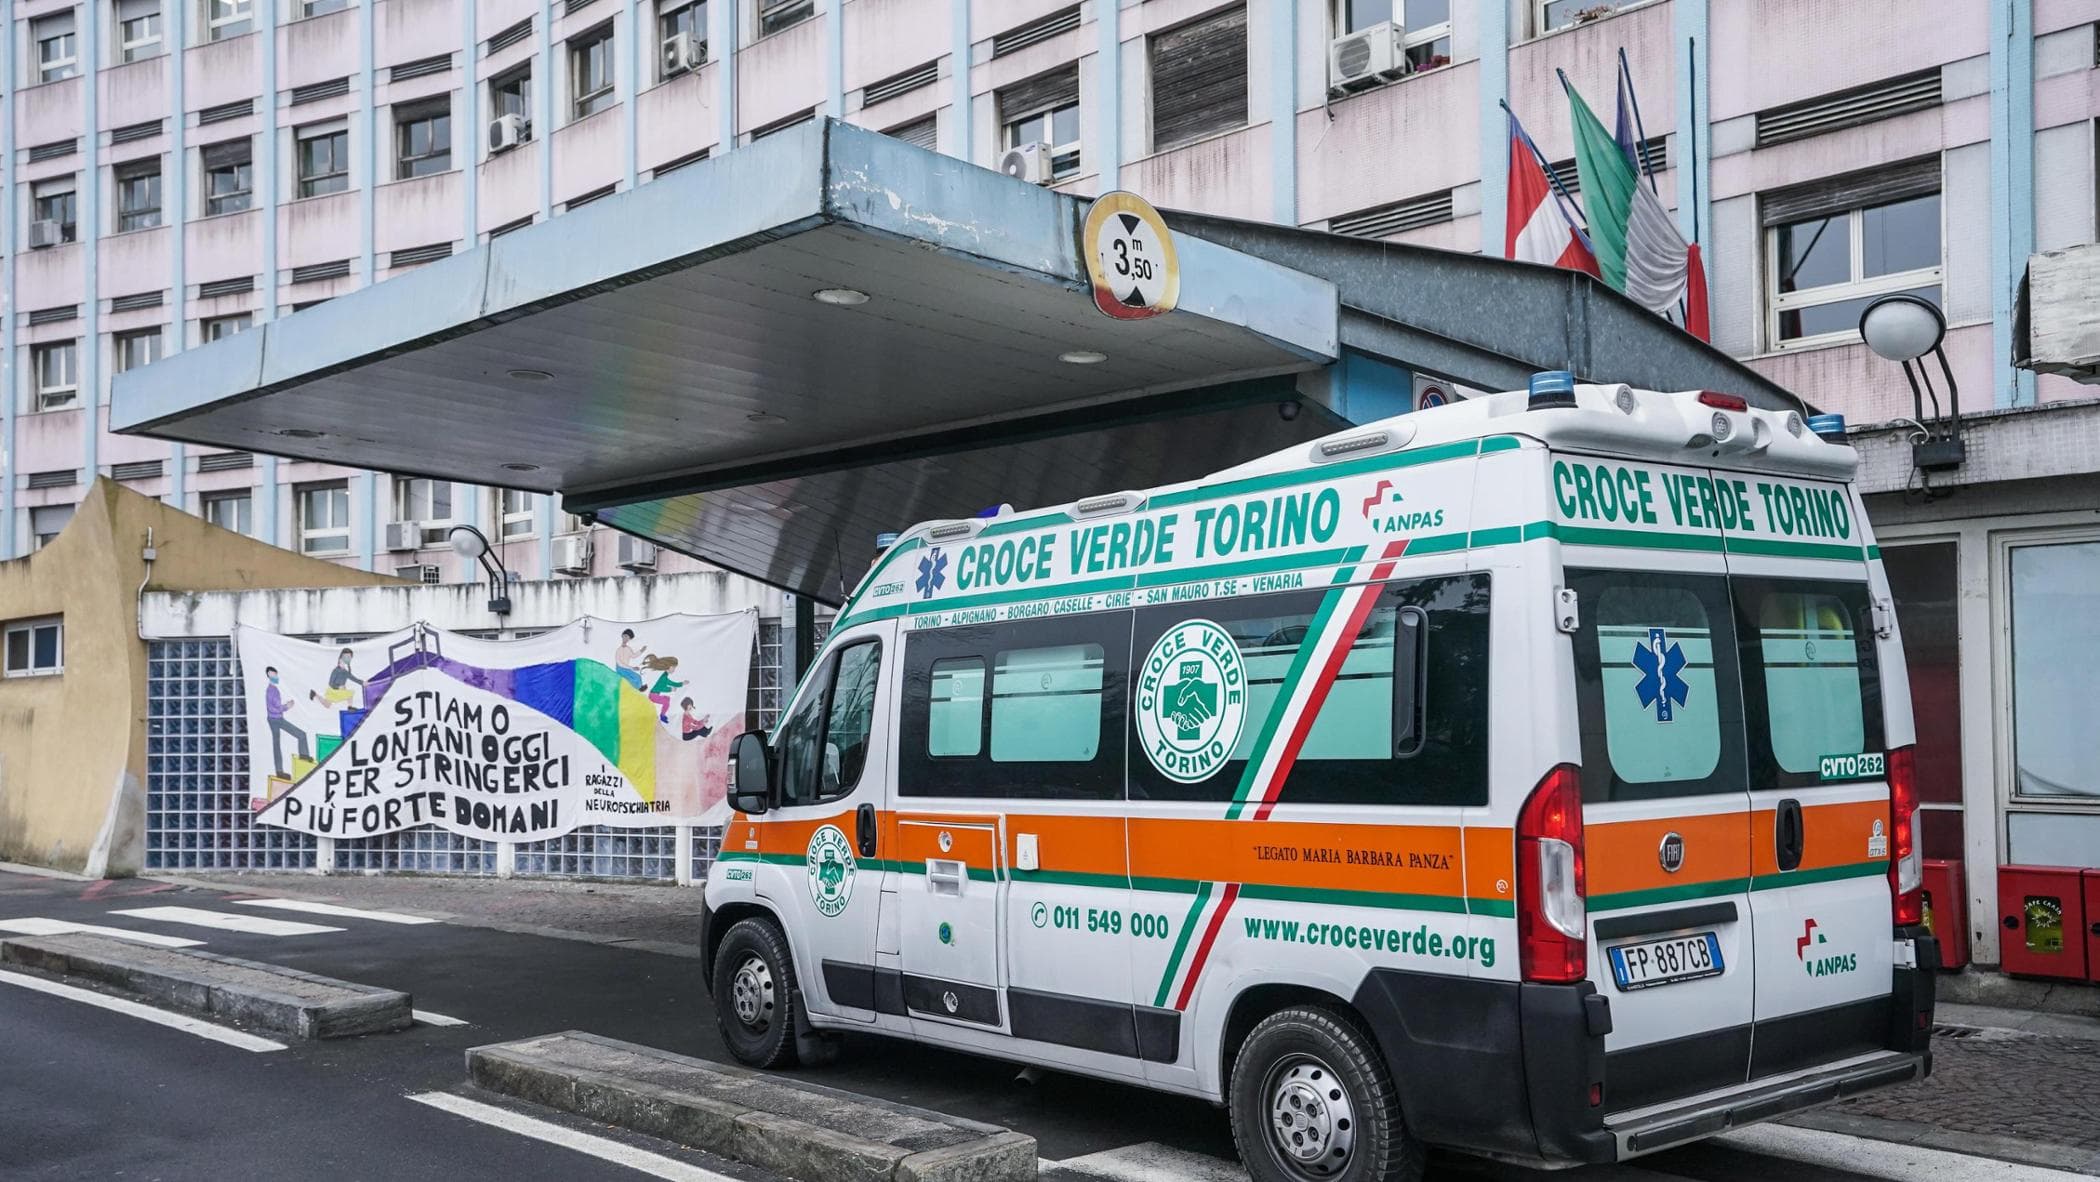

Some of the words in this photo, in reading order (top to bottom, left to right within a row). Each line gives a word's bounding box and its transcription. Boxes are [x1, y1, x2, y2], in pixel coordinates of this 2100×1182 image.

[1553, 460, 1658, 524] CROCE
[1661, 472, 1755, 532] VERDE
[1758, 482, 1850, 540] TORINO
[1384, 509, 1444, 533] ANPAS
[956, 533, 1056, 590] CROCE
[1070, 514, 1178, 576] VERDE
[1194, 487, 1340, 558] TORINO
[914, 614, 942, 628] TORINO
[952, 608, 996, 624] ALPIGNANO
[1147, 591, 1168, 604] SAN
[1172, 586, 1208, 600] MAURO
[1214, 580, 1237, 596] T.SE
[1253, 573, 1303, 592] VENARIA
[1142, 632, 1186, 711] CROCE
[1202, 630, 1241, 705] VERDE
[1182, 664, 1200, 674] 1907
[395, 691, 509, 735] STIAMO
[351, 724, 472, 767] LONTANI
[482, 732, 548, 764] OGGI
[1155, 740, 1224, 774] TORINO
[325, 767, 381, 803] PER
[395, 753, 569, 794] STRINGERCI
[586, 774, 622, 788] RAGAZZI
[602, 764, 605, 773] I
[1821, 756, 1856, 777] CVTO
[1860, 756, 1882, 774] 262
[586, 799, 670, 814] NEUROPSICHIATRIA
[594, 788, 614, 798] DELLA
[284, 797, 336, 833] PIÙ
[342, 792, 446, 834] FORTE
[454, 796, 558, 834] DOMANI
[810, 832, 826, 876] CROCE
[832, 832, 854, 876] VERDE
[1303, 848, 1341, 864] MARIA
[1346, 850, 1403, 868] BARBARA
[1667, 844, 1680, 862] FIAT
[816, 893, 846, 914] TORINO
[1054, 906, 1079, 930] 011
[1088, 908, 1122, 934] 549
[1130, 912, 1168, 939] 000
[1244, 917, 1496, 968] www.croceverde.org
[1625, 947, 1648, 980] FP
[1654, 938, 1710, 974] 887CB
[1816, 953, 1856, 978] ANPAS
